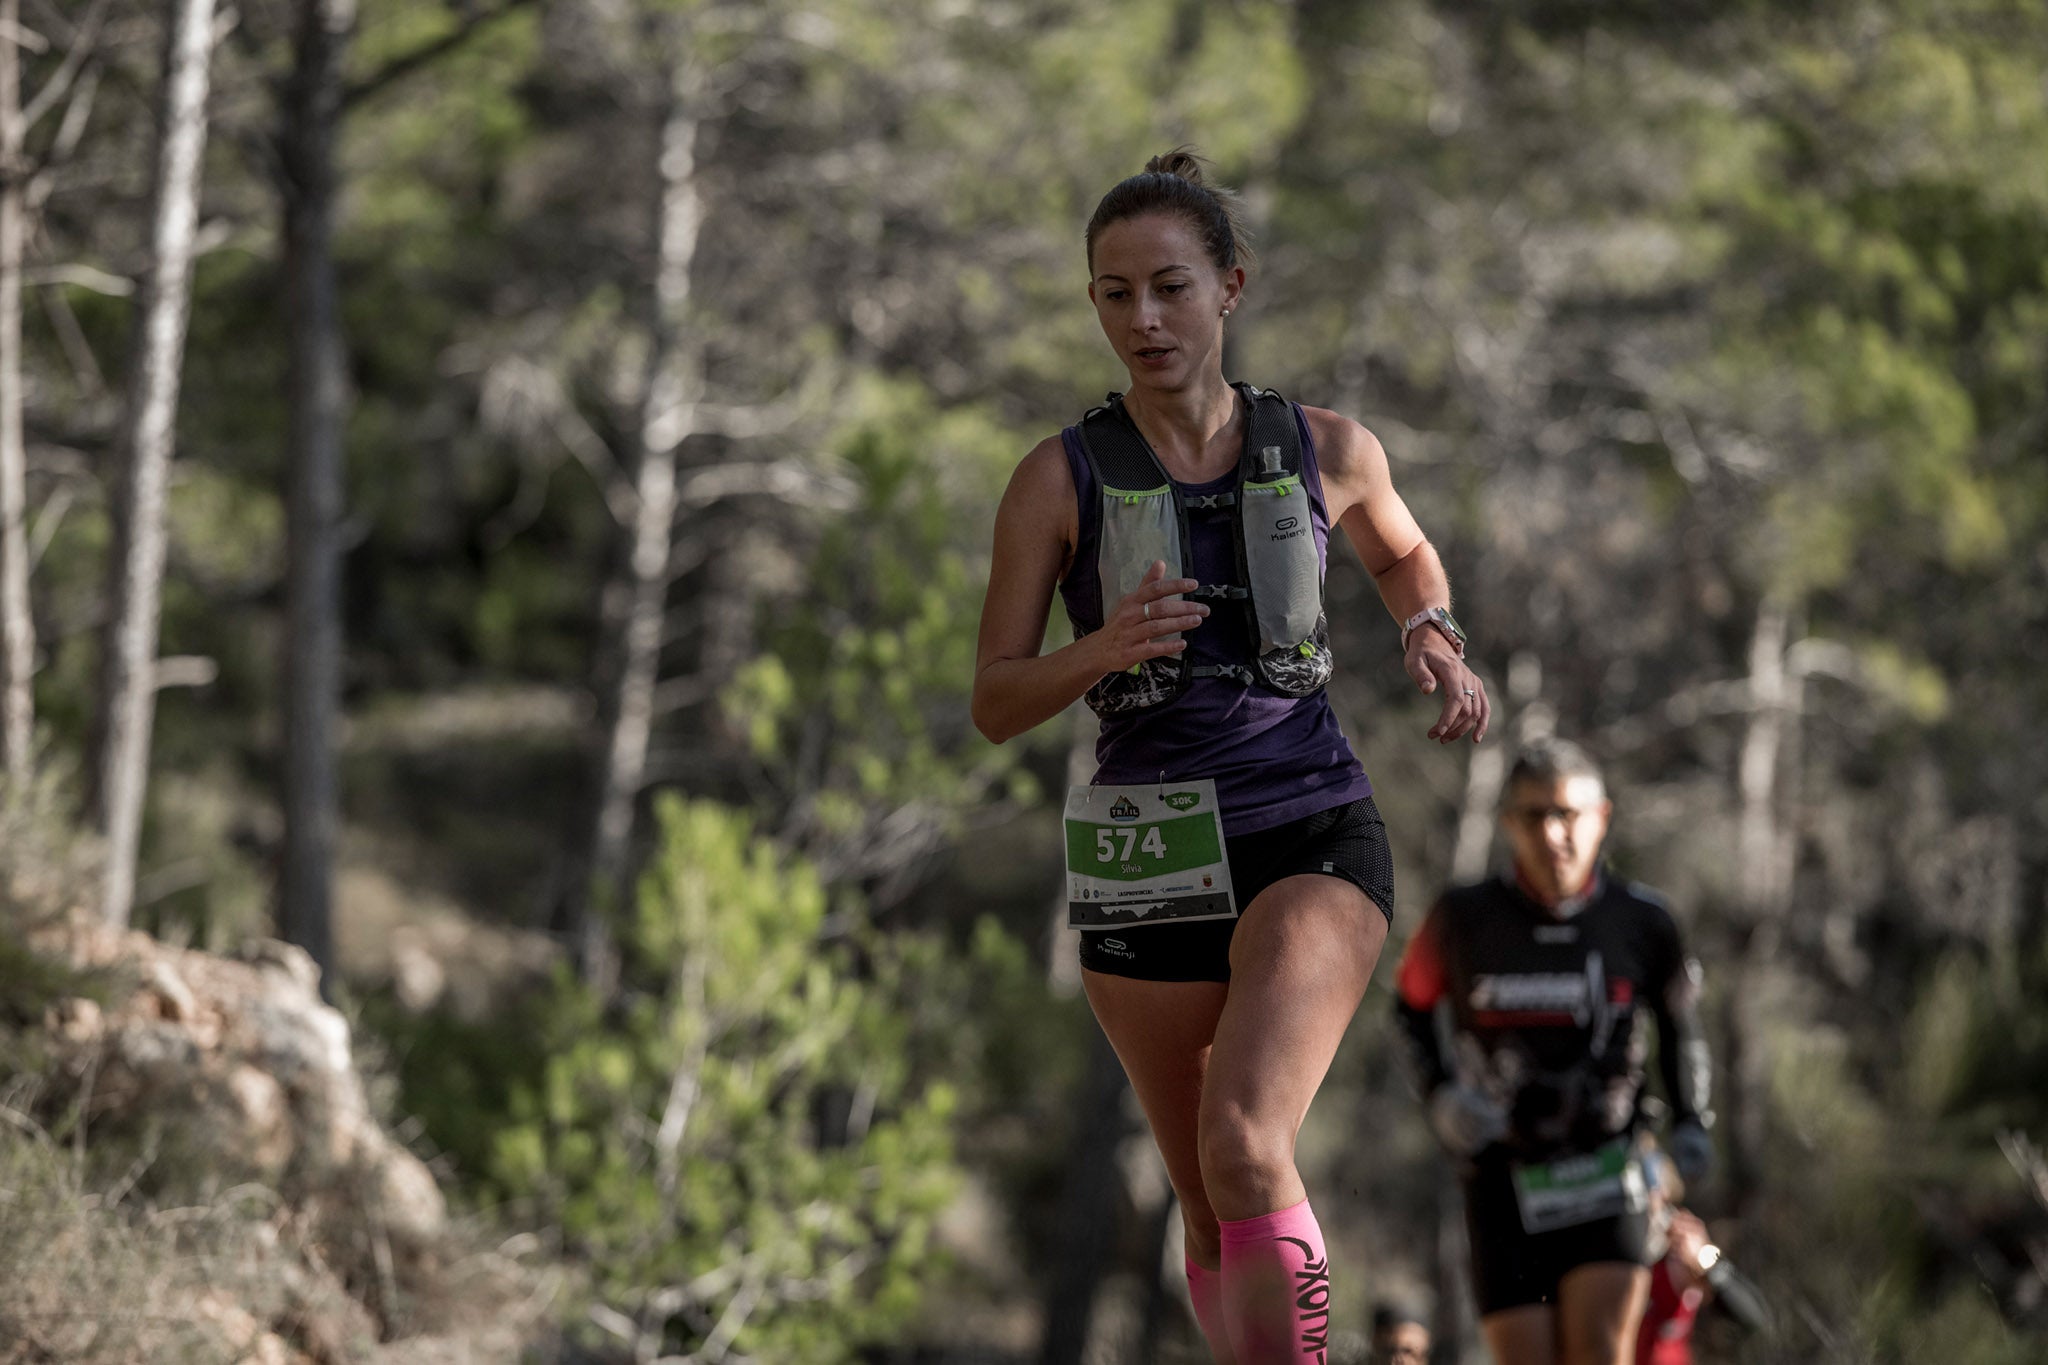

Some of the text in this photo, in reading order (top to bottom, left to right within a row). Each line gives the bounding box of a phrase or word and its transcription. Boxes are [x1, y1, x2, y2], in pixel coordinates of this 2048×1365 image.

[1271, 528, 1306, 542] Kalenji
[1172, 796, 1193, 806] 30K
[1112, 807, 1138, 816] TRAIL
[1096, 826, 1167, 863] 574
[1121, 863, 1142, 875] Silvia
[1097, 943, 1135, 960] Kalenji
